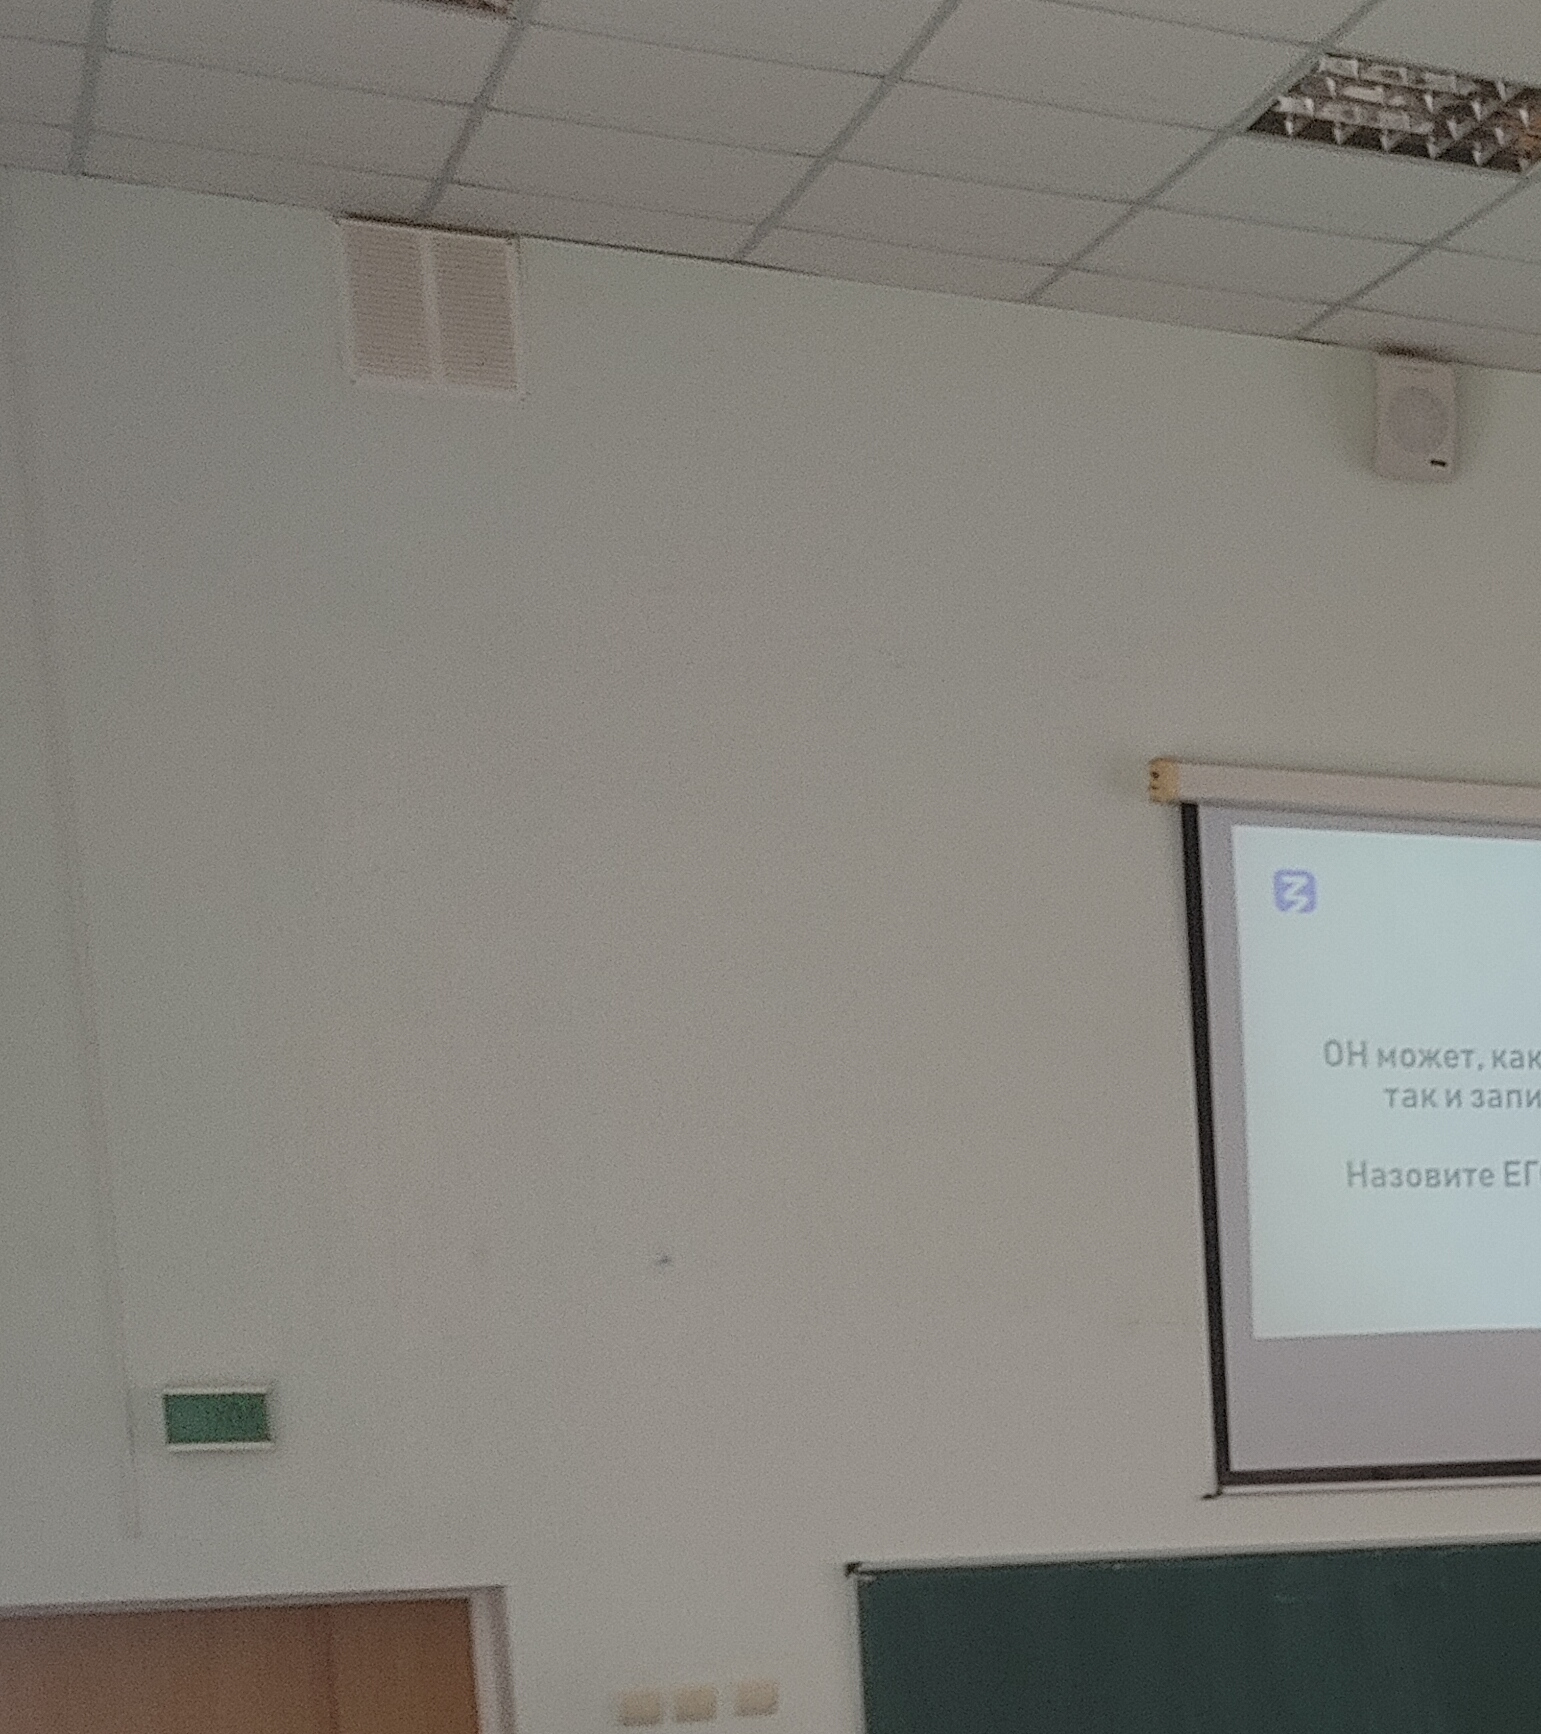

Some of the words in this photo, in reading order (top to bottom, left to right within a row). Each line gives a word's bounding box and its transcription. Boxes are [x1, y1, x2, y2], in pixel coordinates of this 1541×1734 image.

[1323, 1038, 1368, 1068] ОН
[1376, 1047, 1484, 1072] может,
[1384, 1087, 1438, 1109] так
[1445, 1088, 1463, 1109] и
[1346, 1159, 1496, 1188] Назовите
